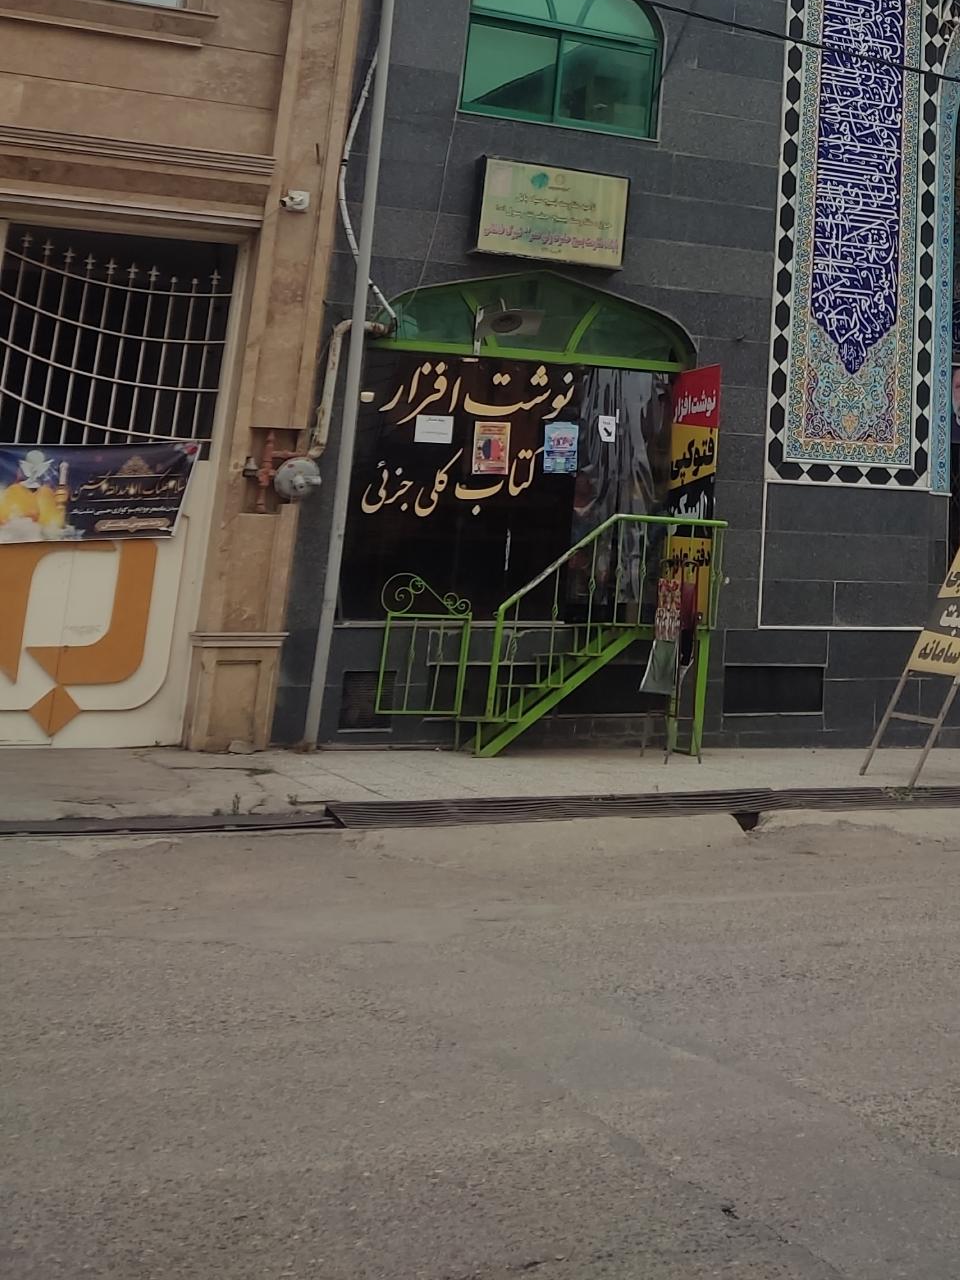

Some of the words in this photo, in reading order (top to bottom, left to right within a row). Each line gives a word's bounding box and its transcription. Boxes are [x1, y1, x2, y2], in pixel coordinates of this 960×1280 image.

[379, 361, 463, 425] افزار
[463, 365, 576, 420] نوشت
[673, 391, 693, 424] افزار
[691, 390, 717, 418] نوشت
[414, 448, 464, 517] کلی
[455, 446, 546, 516] کتاب
[670, 427, 716, 487] فتوکپی
[361, 460, 414, 514] جزئی
